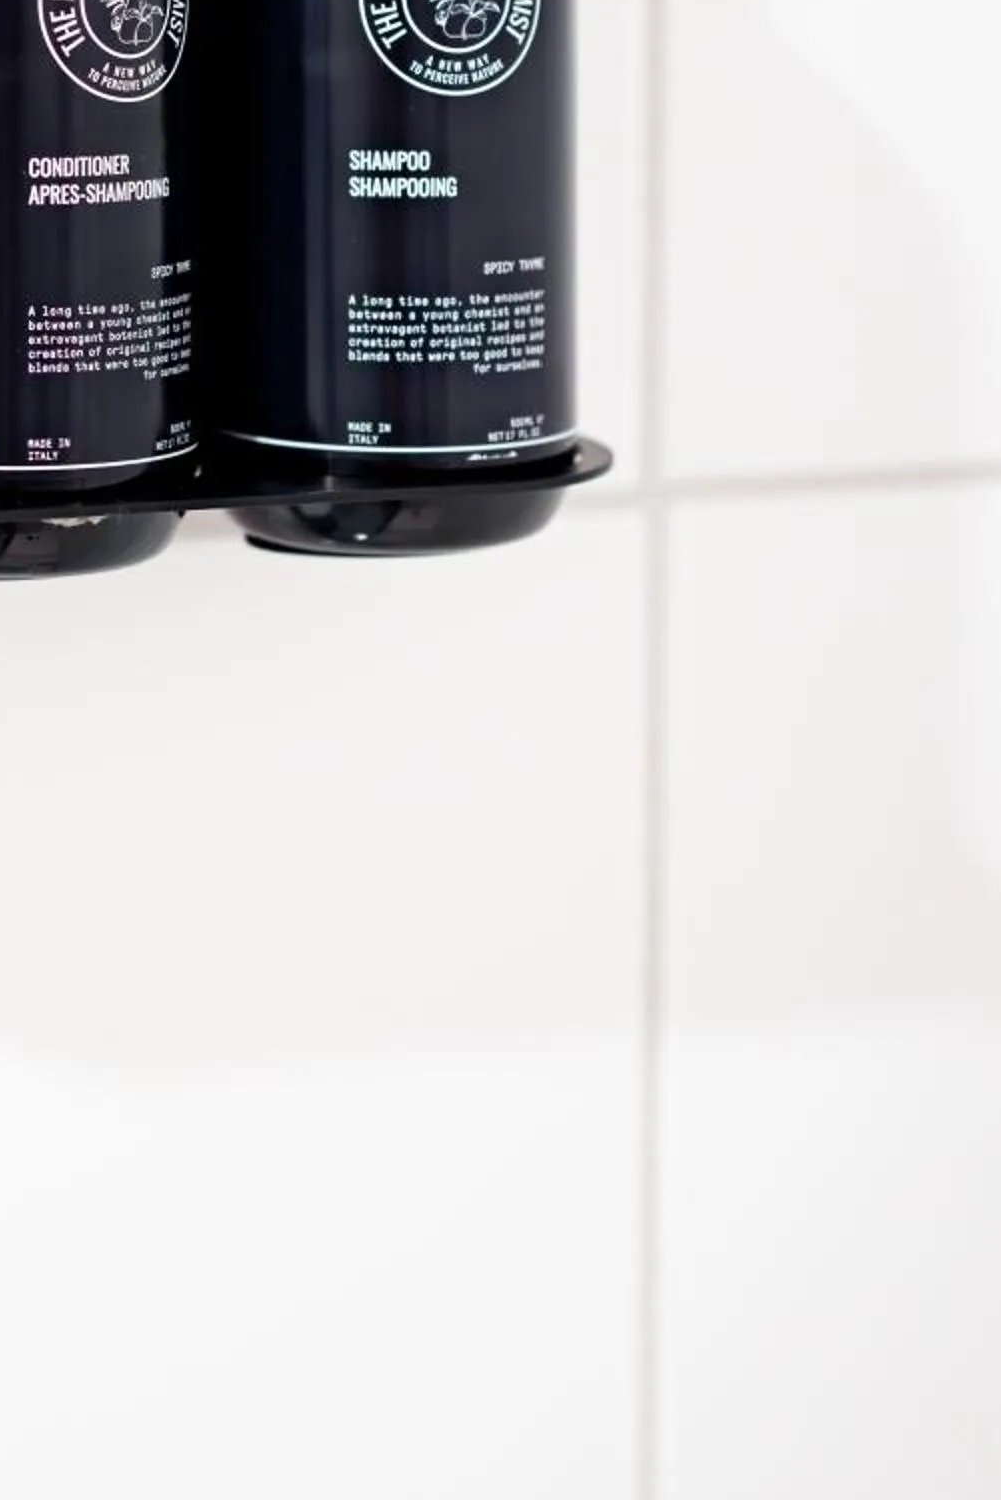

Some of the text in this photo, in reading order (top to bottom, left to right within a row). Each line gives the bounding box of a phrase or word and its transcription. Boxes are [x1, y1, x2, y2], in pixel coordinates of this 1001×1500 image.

[49, 6, 86, 57] THE
[371, 0, 408, 50] THE
[28, 154, 130, 178] CONDITIONER
[349, 149, 431, 172] SHAMPOO
[28, 177, 170, 205] APRES-SHAMPOOING
[349, 176, 458, 198] SHAMPOOING
[348, 294, 356, 306] A
[362, 294, 393, 309] long
[399, 295, 429, 307] time
[28, 305, 36, 317] A
[42, 305, 72, 319] long
[78, 304, 106, 315] time
[348, 308, 401, 320] between
[409, 311, 416, 320] a
[422, 310, 459, 322] young
[28, 320, 81, 331] between
[87, 321, 94, 329] a
[348, 323, 427, 336] extravagant
[28, 332, 103, 347] extravagant
[348, 337, 405, 349] creation
[410, 337, 424, 349] of
[429, 335, 481, 350] original
[28, 348, 84, 360] creation
[89, 346, 101, 357] of
[348, 349, 390, 362] blends
[396, 351, 423, 362] that
[427, 351, 455, 362] were
[461, 350, 480, 361] too
[28, 362, 70, 373] blends
[75, 361, 100, 372] that
[105, 360, 129, 370] were
[348, 422, 391, 433] MADE IN
[28, 438, 71, 448] MADE IN
[349, 434, 379, 444] ITALY
[28, 451, 59, 461] ITALY
